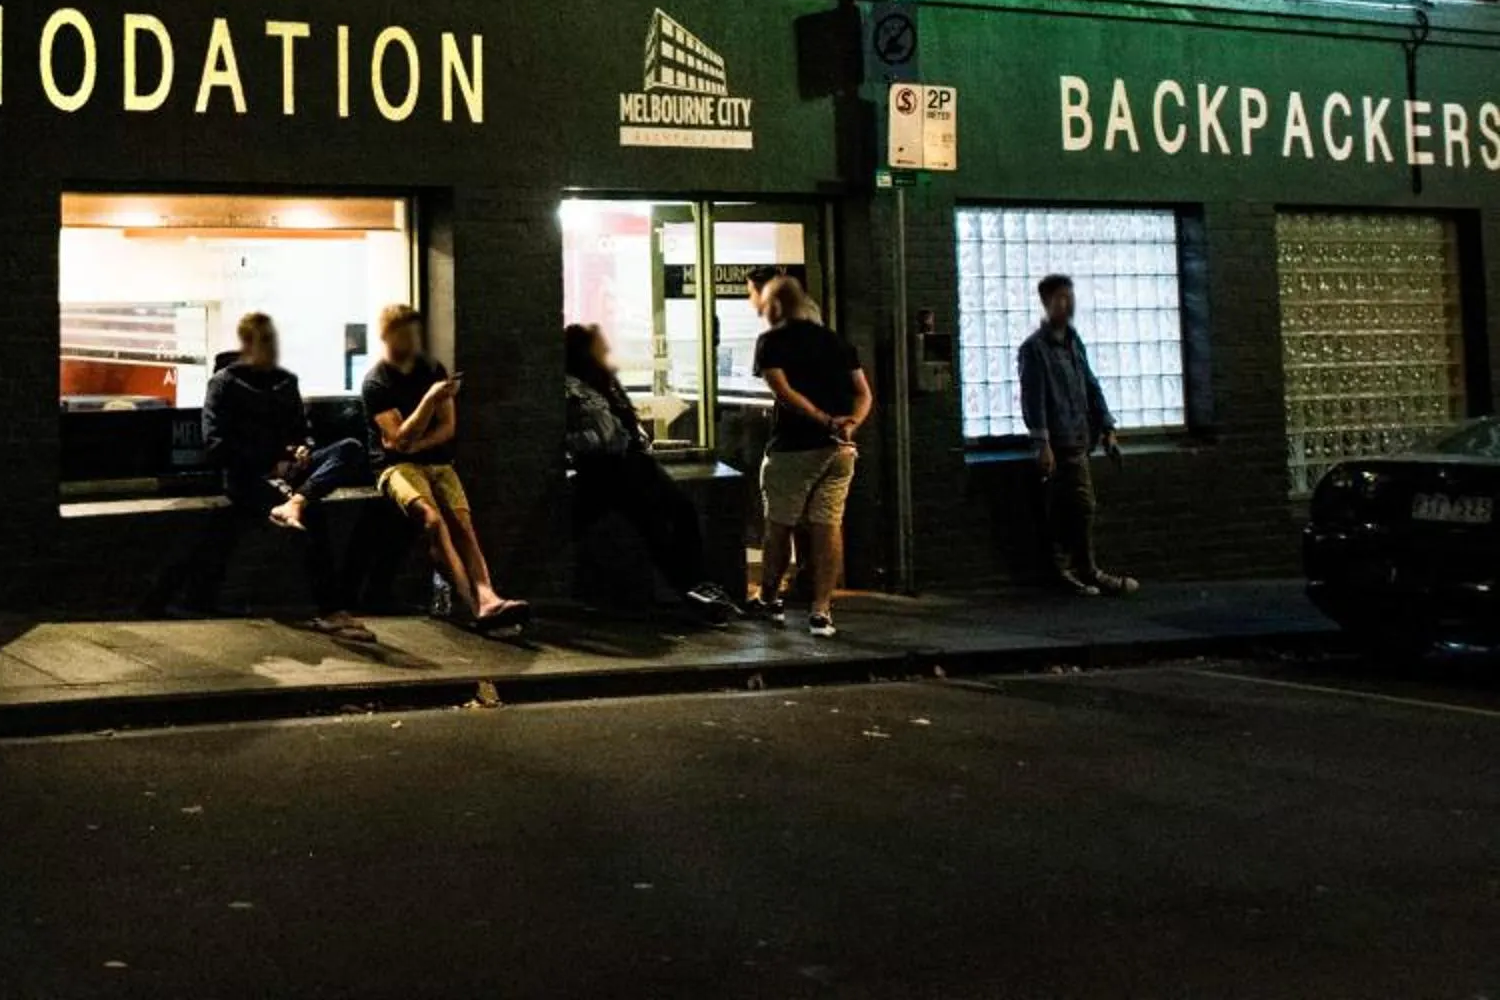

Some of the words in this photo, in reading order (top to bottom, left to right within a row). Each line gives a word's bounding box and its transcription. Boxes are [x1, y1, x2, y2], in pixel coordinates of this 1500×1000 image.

[620, 94, 715, 126] MELBOURNE
[717, 97, 752, 127] CITY
[928, 89, 951, 109] 2P
[1060, 75, 1500, 171] BACKPACKERS
